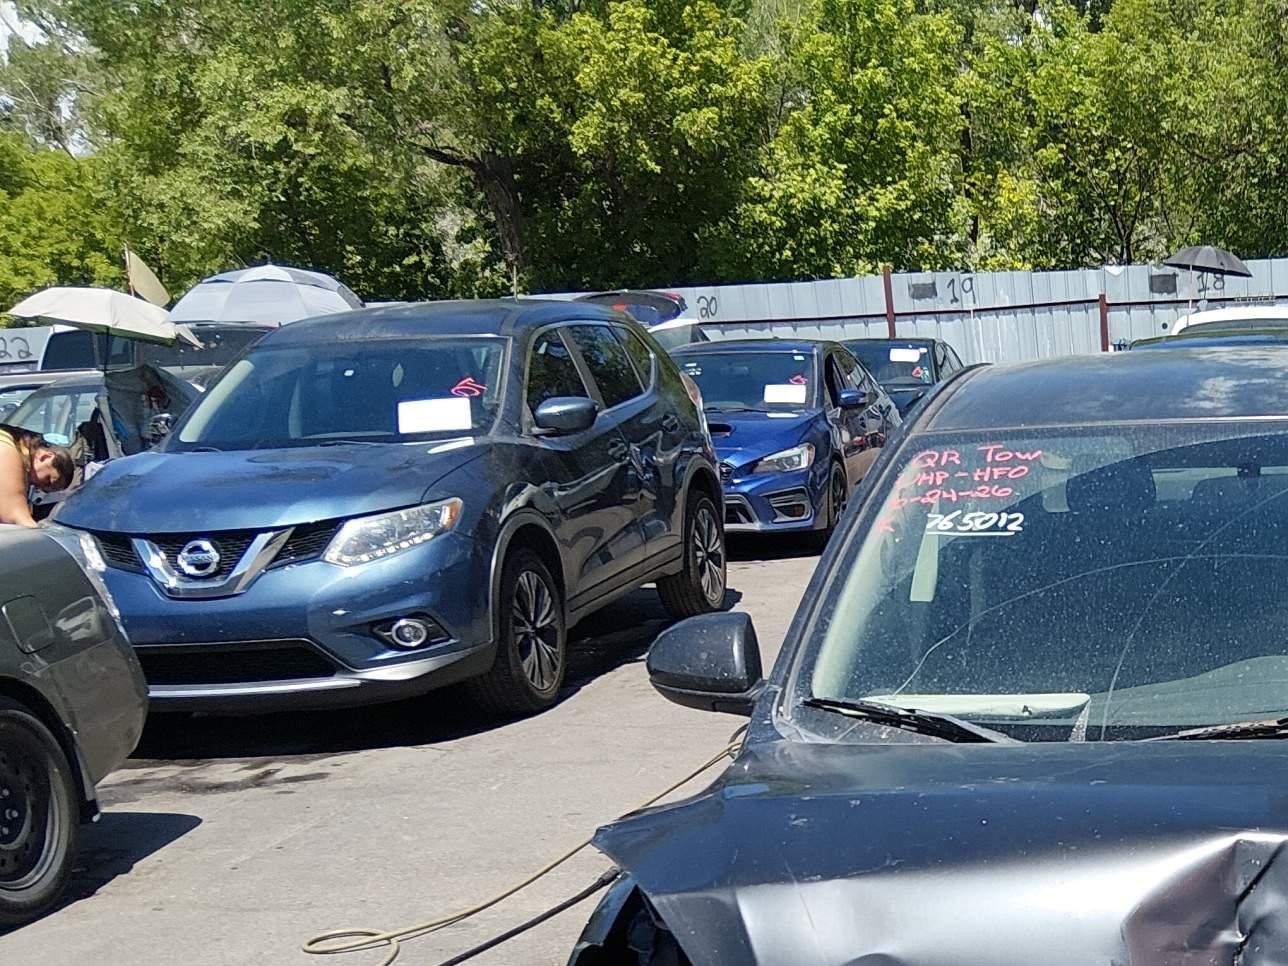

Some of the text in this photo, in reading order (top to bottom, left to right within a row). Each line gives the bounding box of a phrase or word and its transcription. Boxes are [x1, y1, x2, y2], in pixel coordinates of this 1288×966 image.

[946, 277, 976, 305] 19
[1197, 271, 1225, 292] 18
[697, 296, 718, 319] 20
